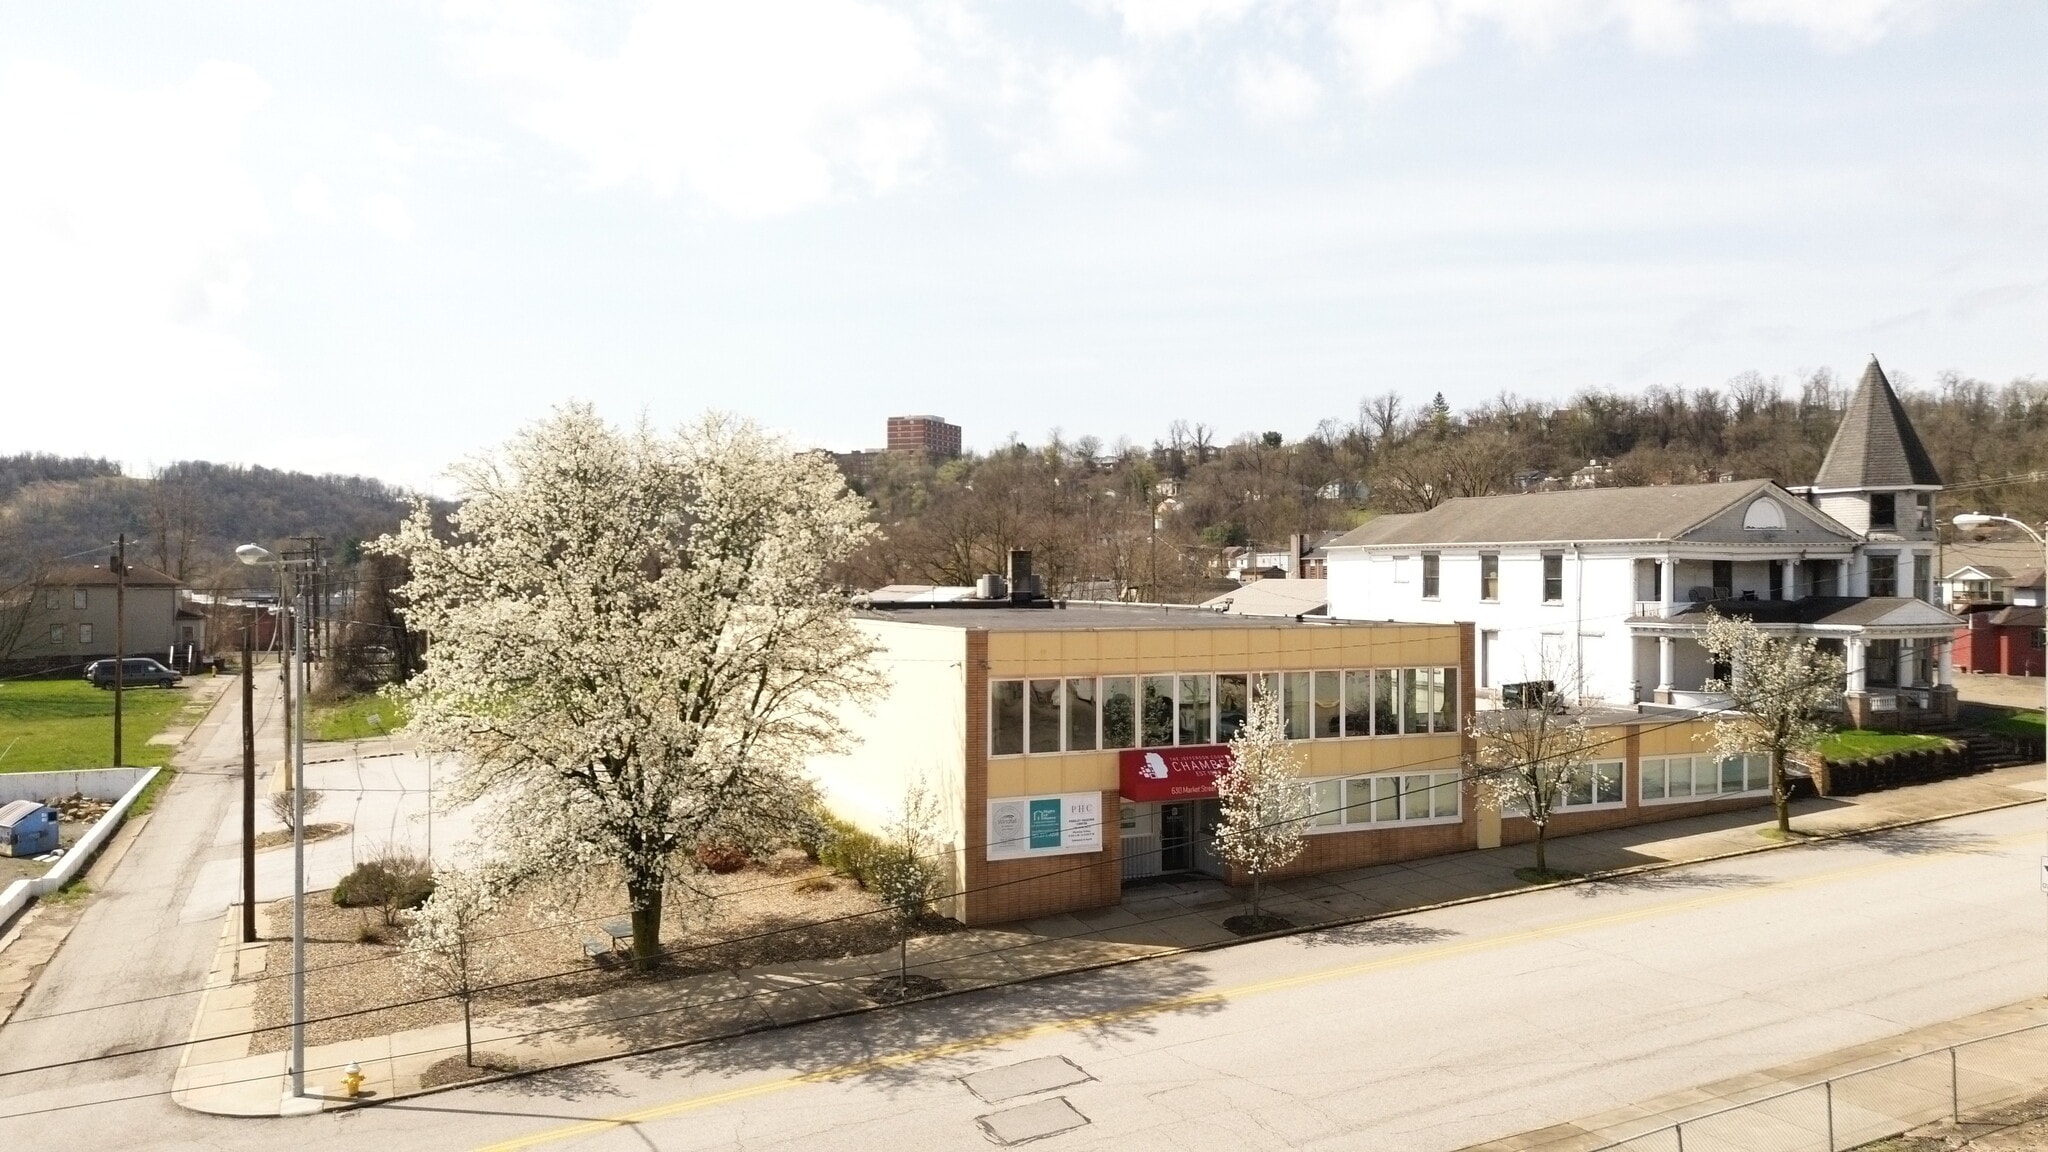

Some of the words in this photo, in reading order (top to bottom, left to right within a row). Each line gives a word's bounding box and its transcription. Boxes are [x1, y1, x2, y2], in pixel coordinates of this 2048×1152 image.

[1171, 786, 1183, 795] 630
[1183, 785, 1200, 794] Market
[1071, 803, 1094, 813] PHC
